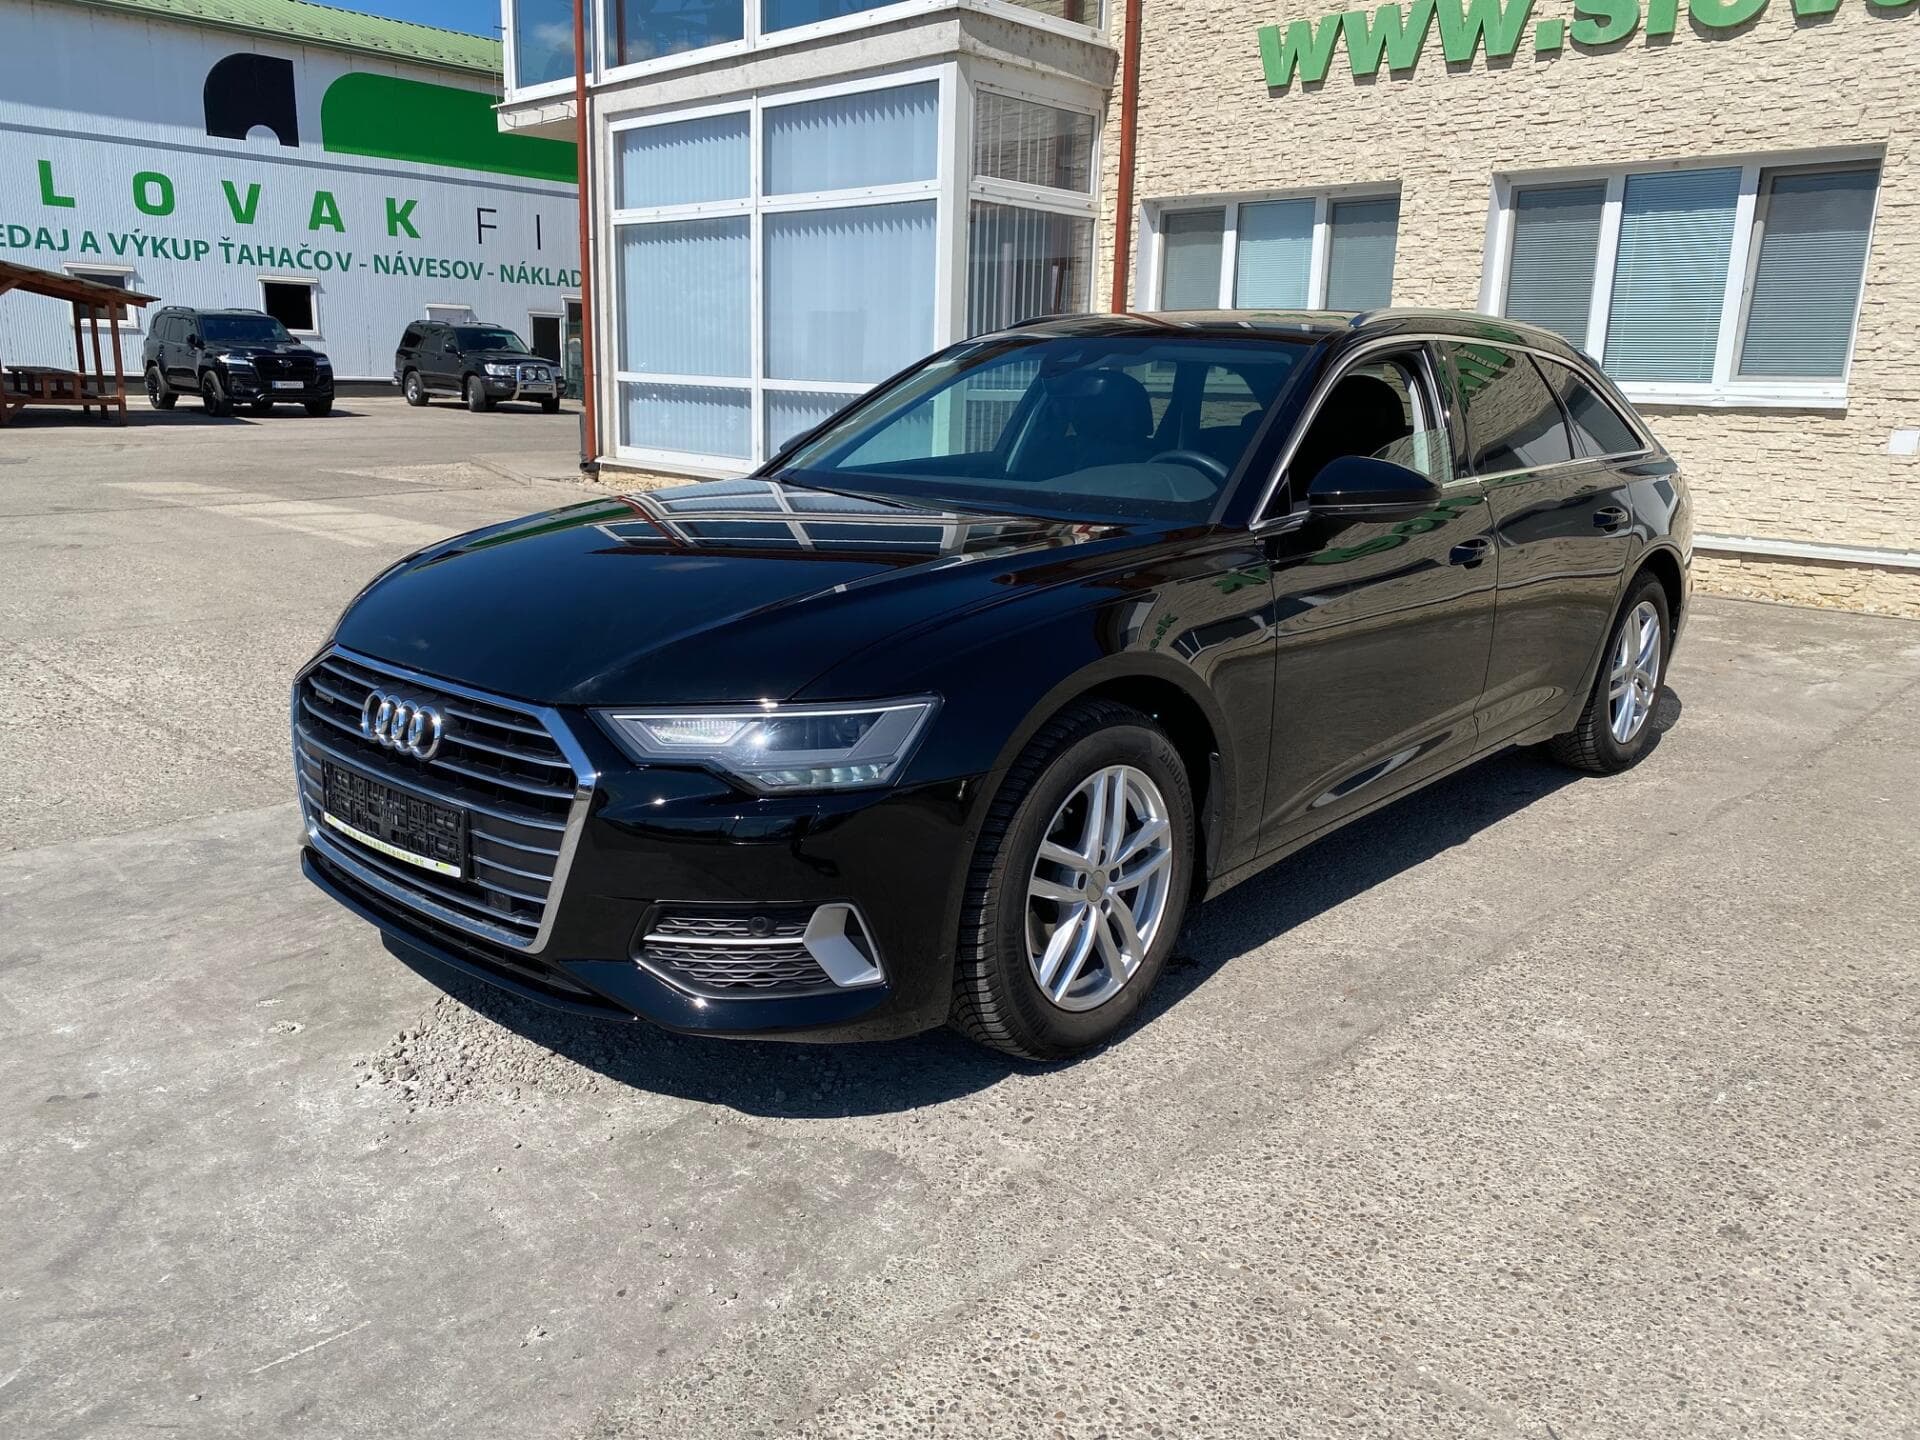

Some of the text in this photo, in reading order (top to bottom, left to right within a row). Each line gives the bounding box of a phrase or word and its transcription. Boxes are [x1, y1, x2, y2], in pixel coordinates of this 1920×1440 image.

[1258, 0, 1911, 88] www.s
[79, 230, 102, 255] A
[107, 228, 210, 262] VÝKUP
[217, 236, 353, 273] ŤAHAČOV
[373, 250, 484, 281] NÁVESOV
